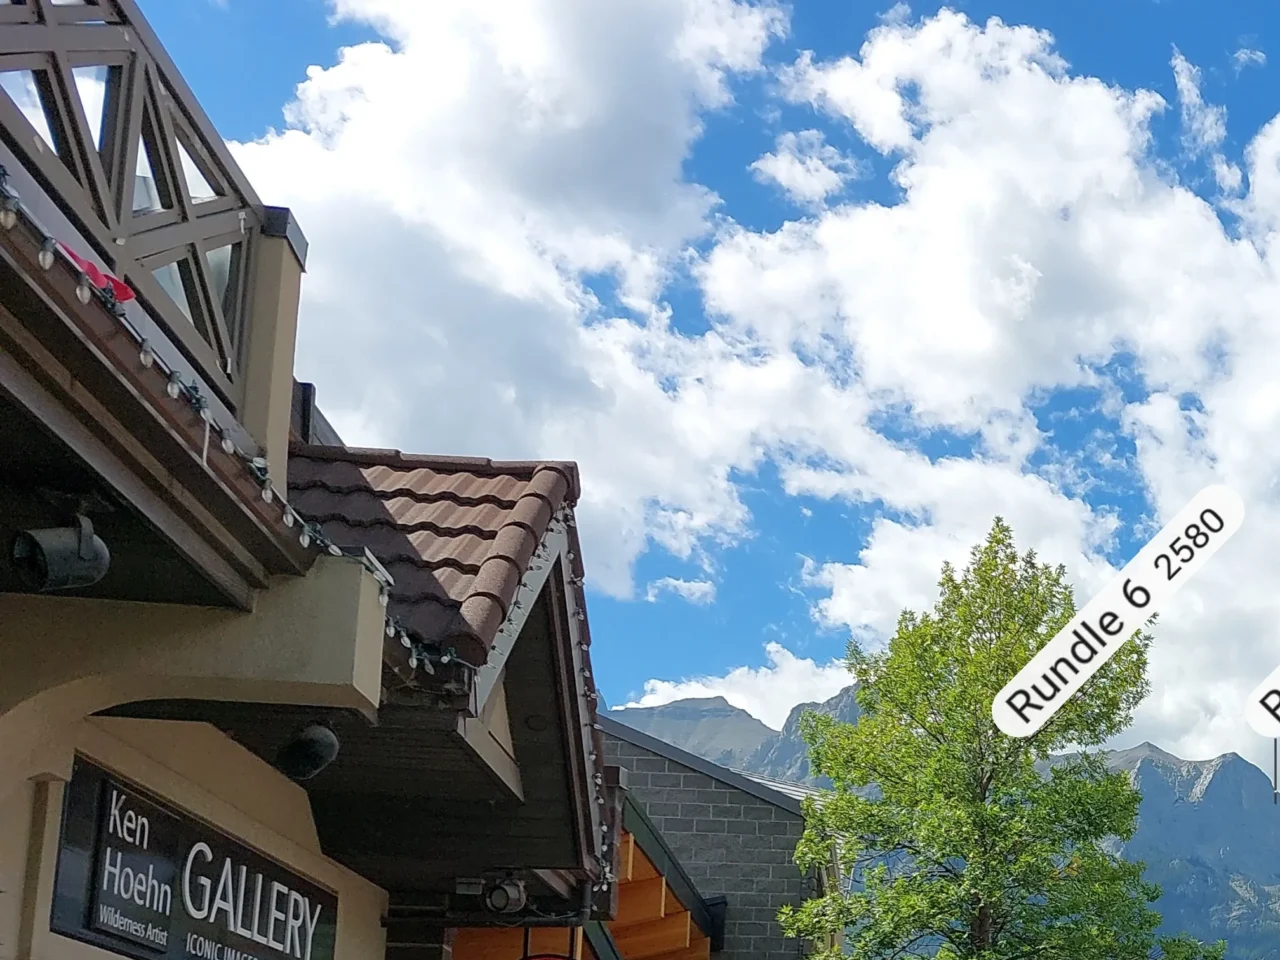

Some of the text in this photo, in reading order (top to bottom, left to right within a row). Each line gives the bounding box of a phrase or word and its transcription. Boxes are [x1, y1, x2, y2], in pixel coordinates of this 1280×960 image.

[109, 789, 149, 850] Ken
[103, 847, 172, 916] Hoehn
[100, 904, 168, 946] Wilderness Artist
